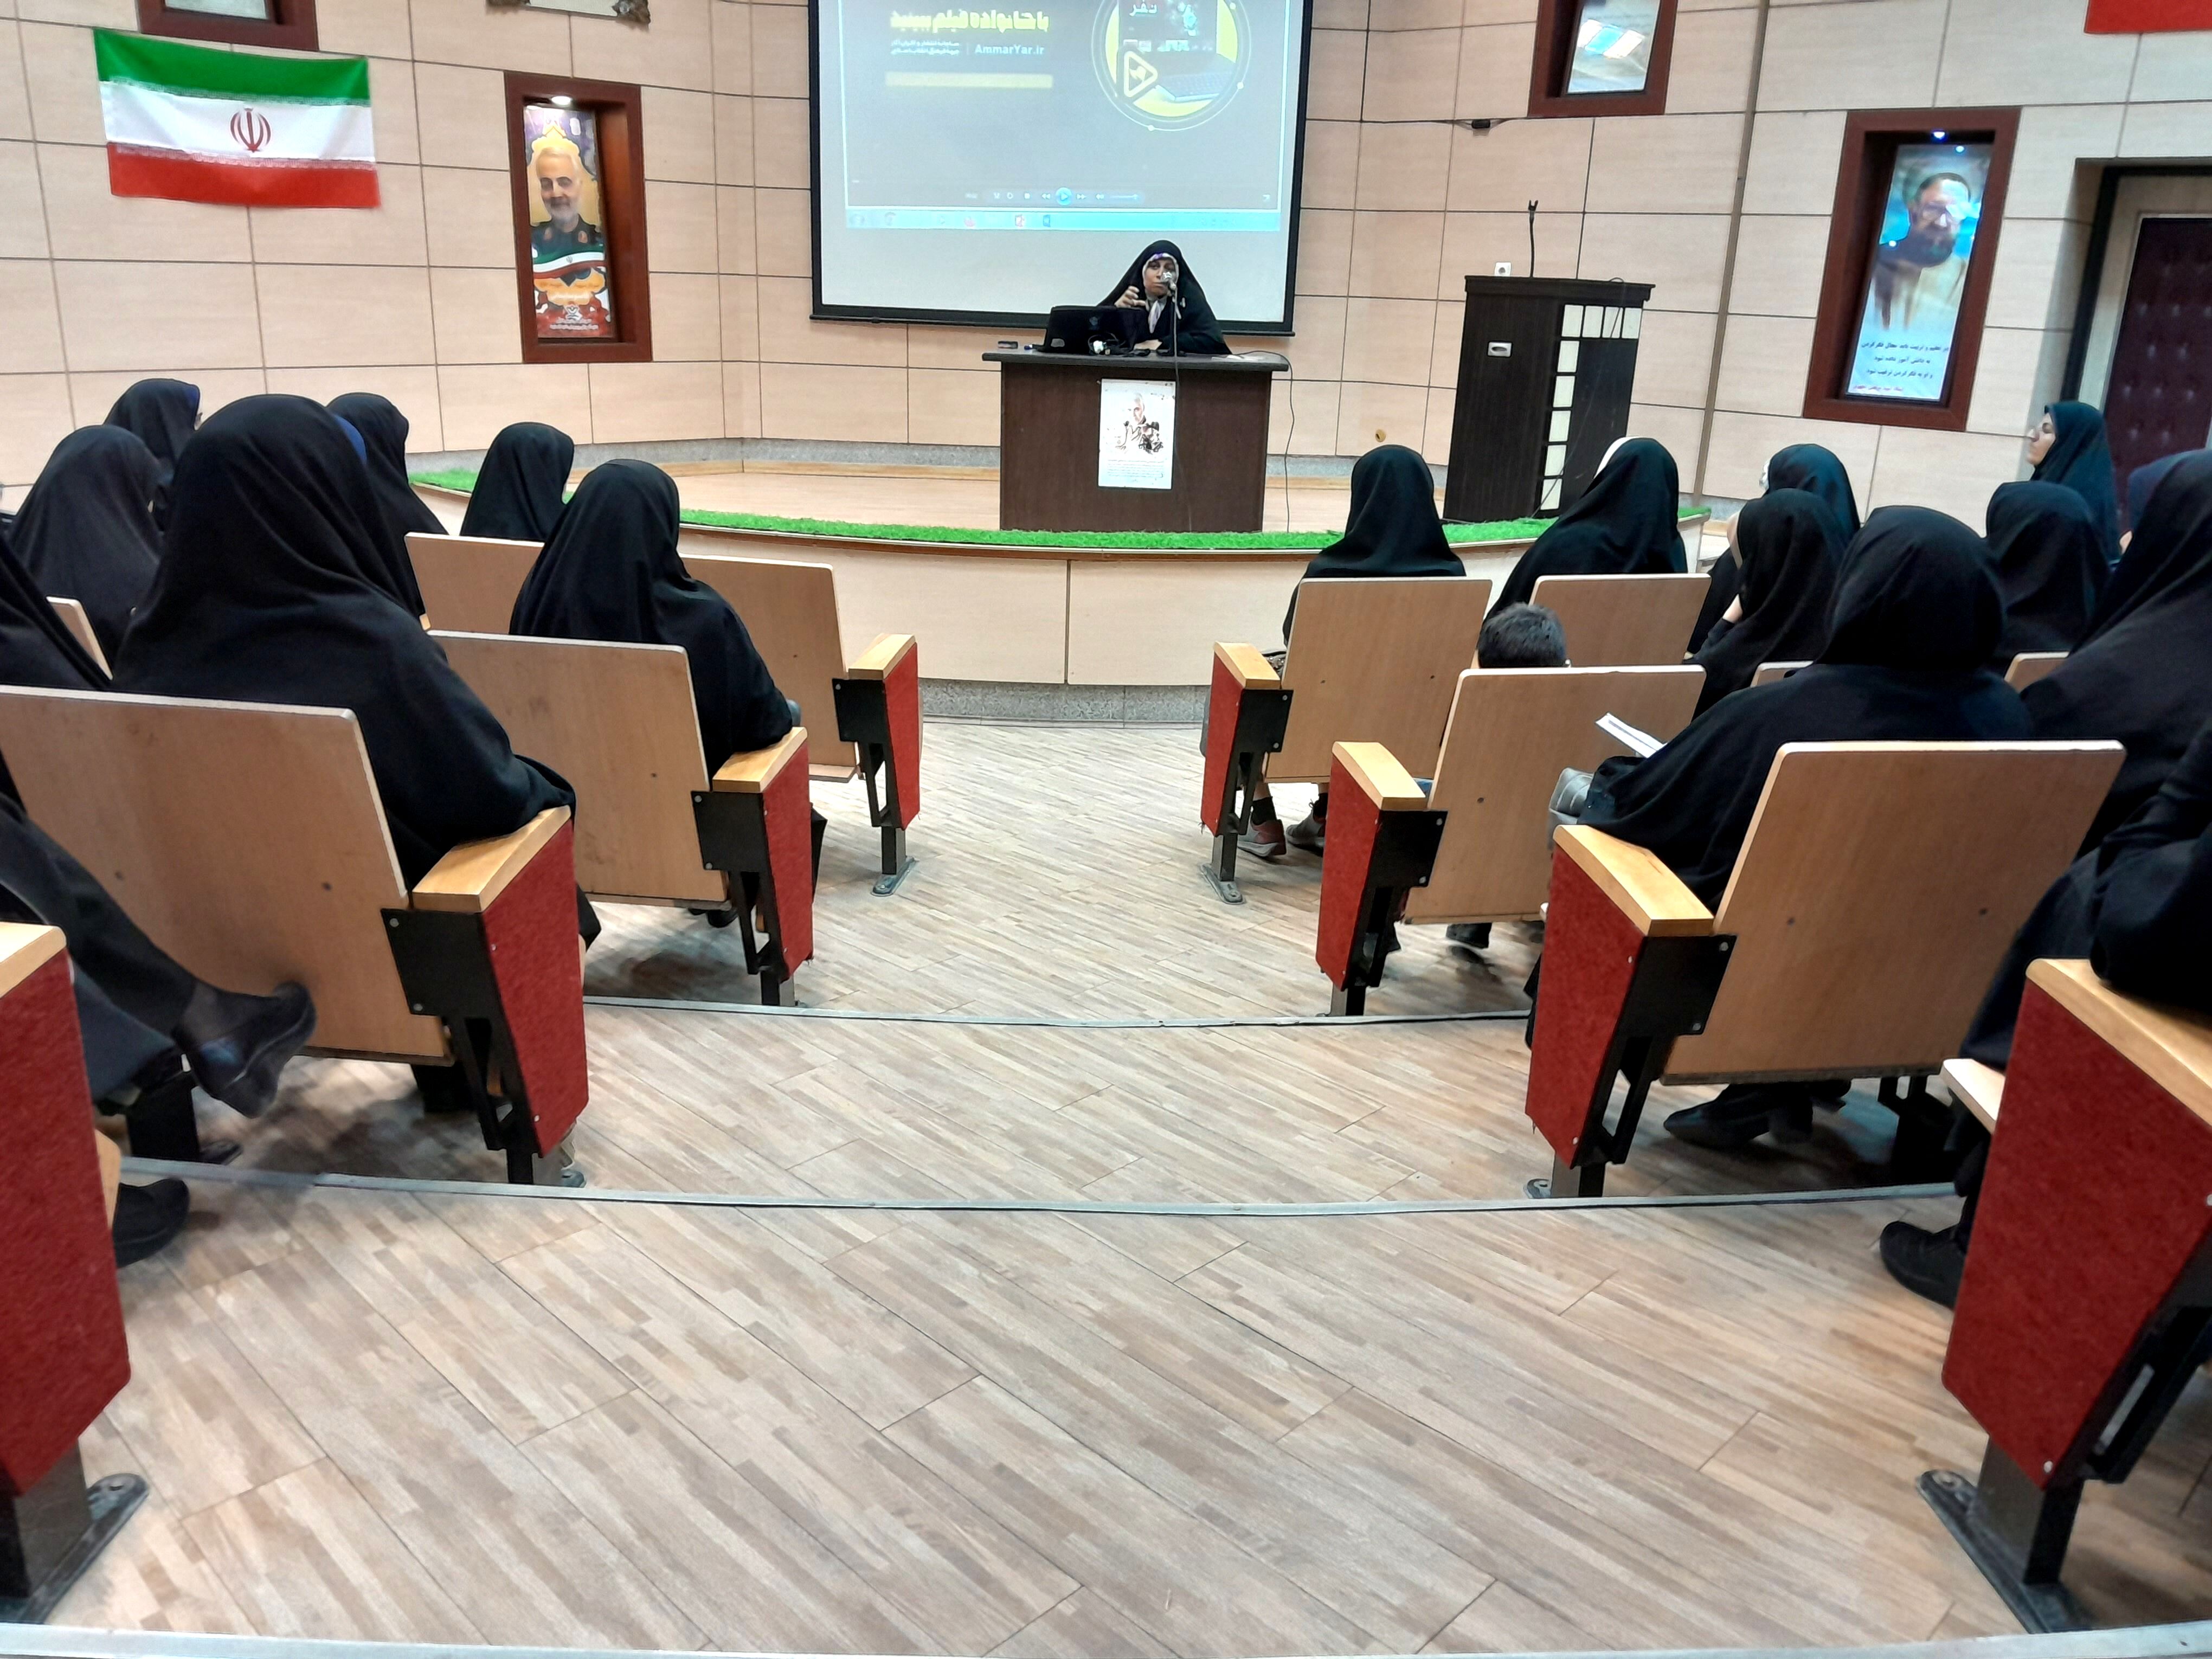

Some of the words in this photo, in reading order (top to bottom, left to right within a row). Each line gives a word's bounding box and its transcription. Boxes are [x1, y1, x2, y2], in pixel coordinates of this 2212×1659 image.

[969, 9, 1037, 33] خانواده
[1036, 11, 1050, 33] با
[975, 44, 1045, 55] AmmarYar.ir
